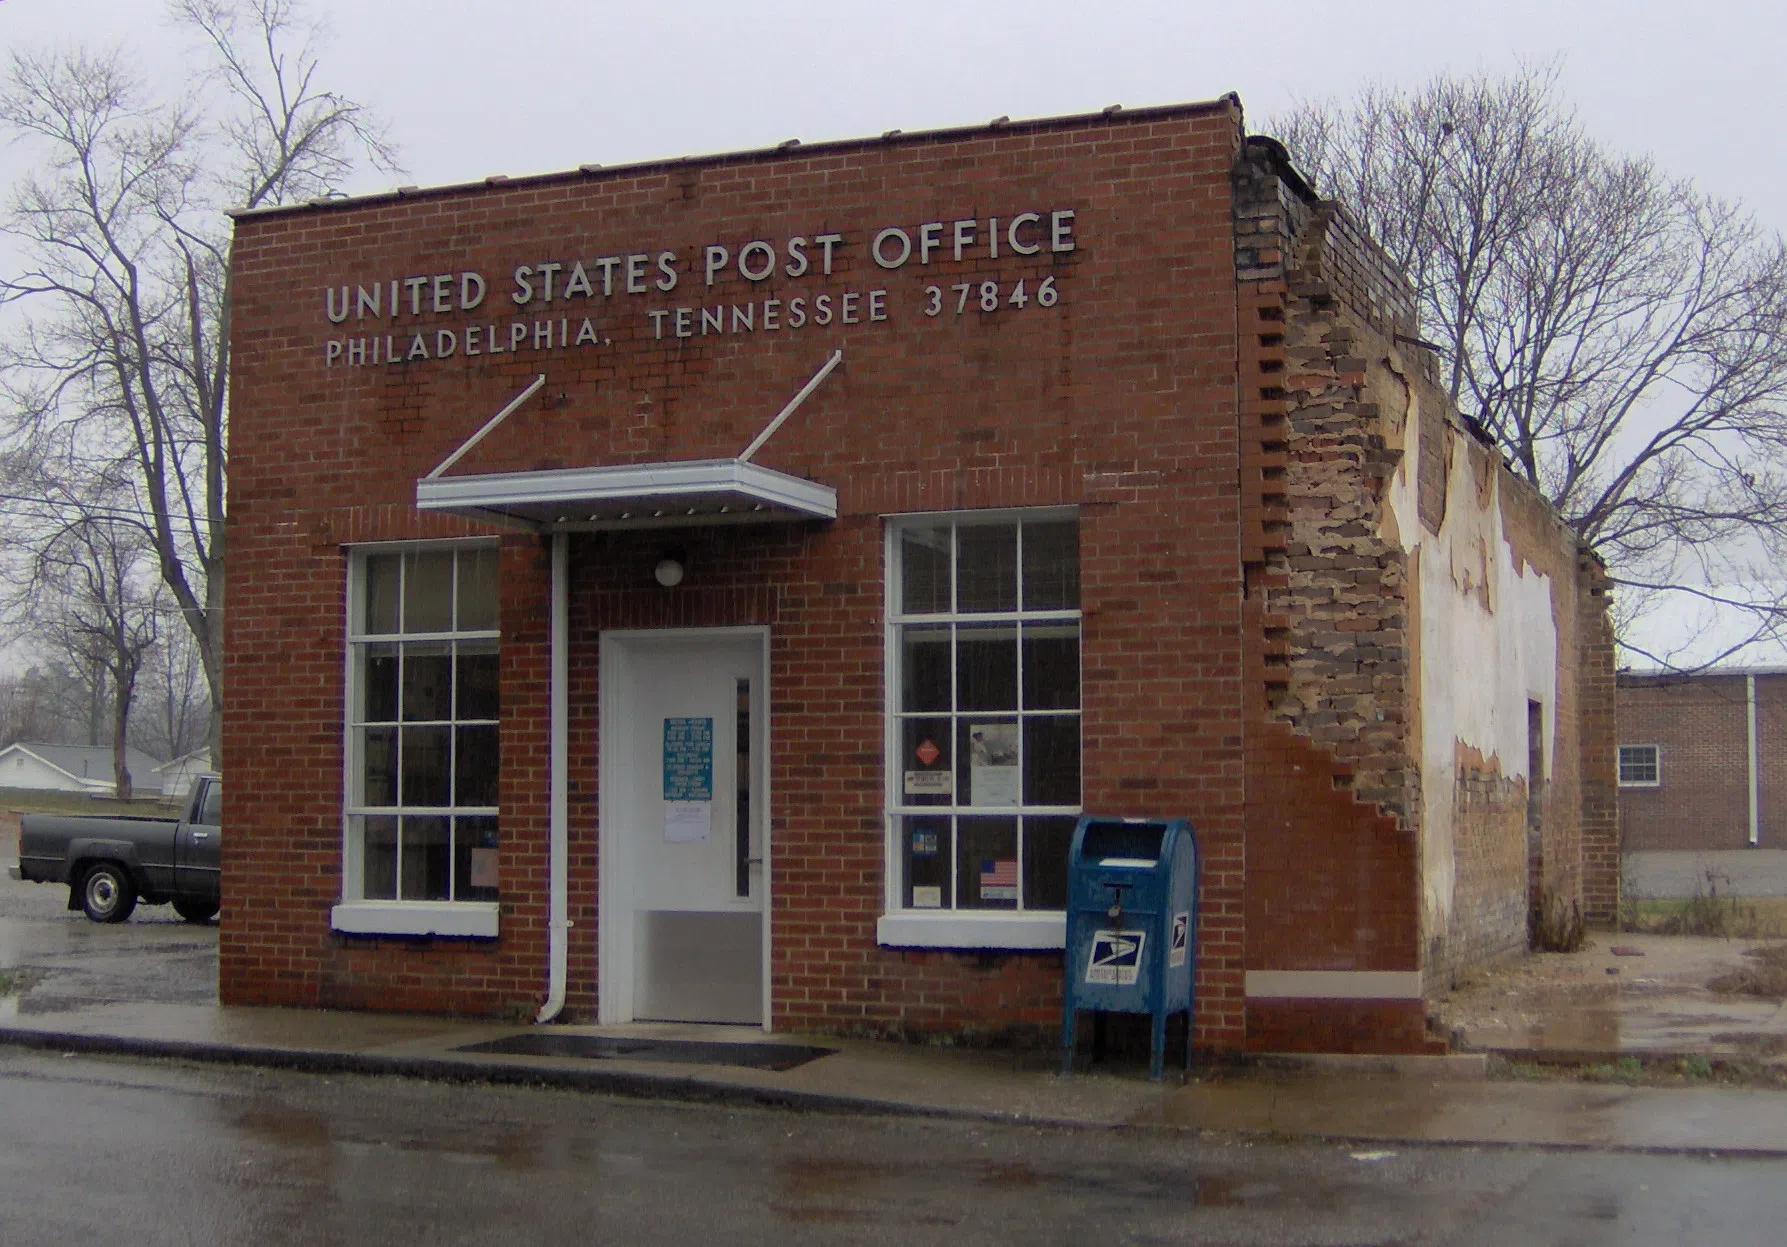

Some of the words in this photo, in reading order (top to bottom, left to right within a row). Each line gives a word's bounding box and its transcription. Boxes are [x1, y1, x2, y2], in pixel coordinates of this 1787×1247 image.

[327, 272, 486, 323] UNITED
[512, 252, 677, 304] STATES
[706, 234, 841, 285] POST
[872, 210, 1075, 268] OFFICE
[649, 290, 887, 340] TENNESSEE
[924, 275, 1058, 316] 37846
